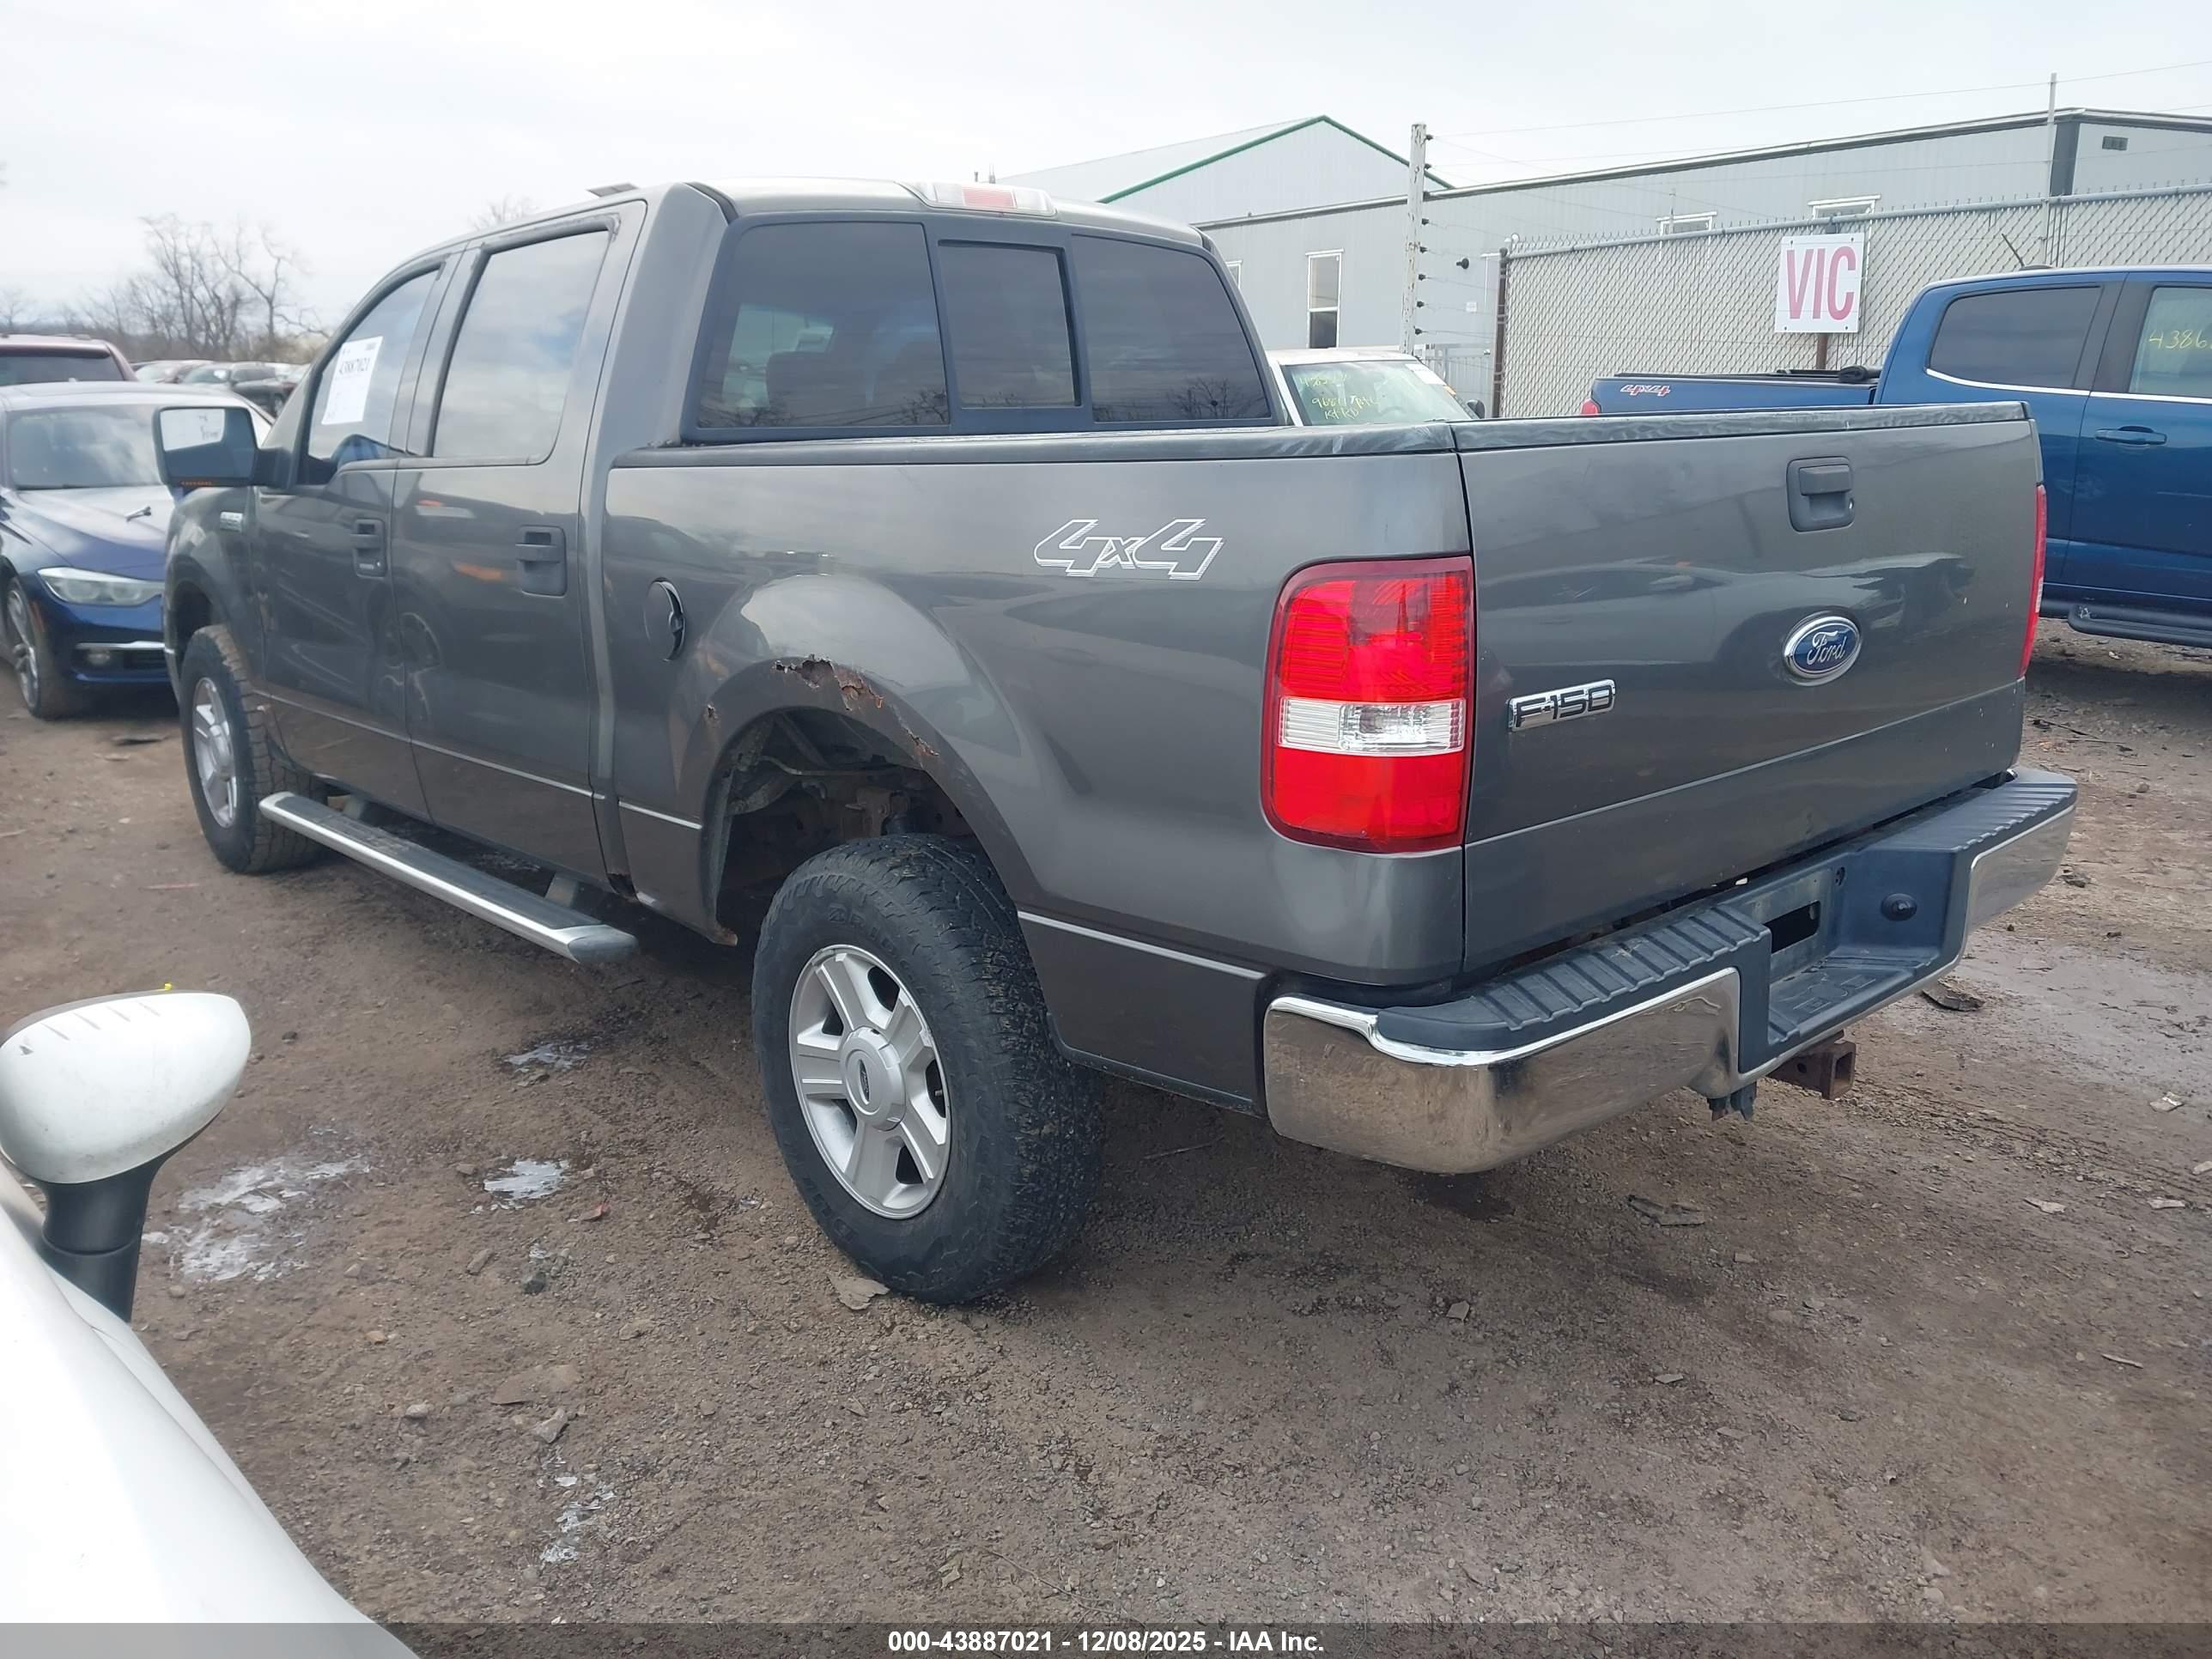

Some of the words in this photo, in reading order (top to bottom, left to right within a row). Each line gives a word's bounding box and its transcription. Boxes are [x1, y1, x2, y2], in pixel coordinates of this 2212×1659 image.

[1786, 246, 1856, 320] VIC
[2148, 329, 2212, 349] 4386
[1807, 630, 1848, 665] Ford
[1516, 684, 1613, 727] F-150
